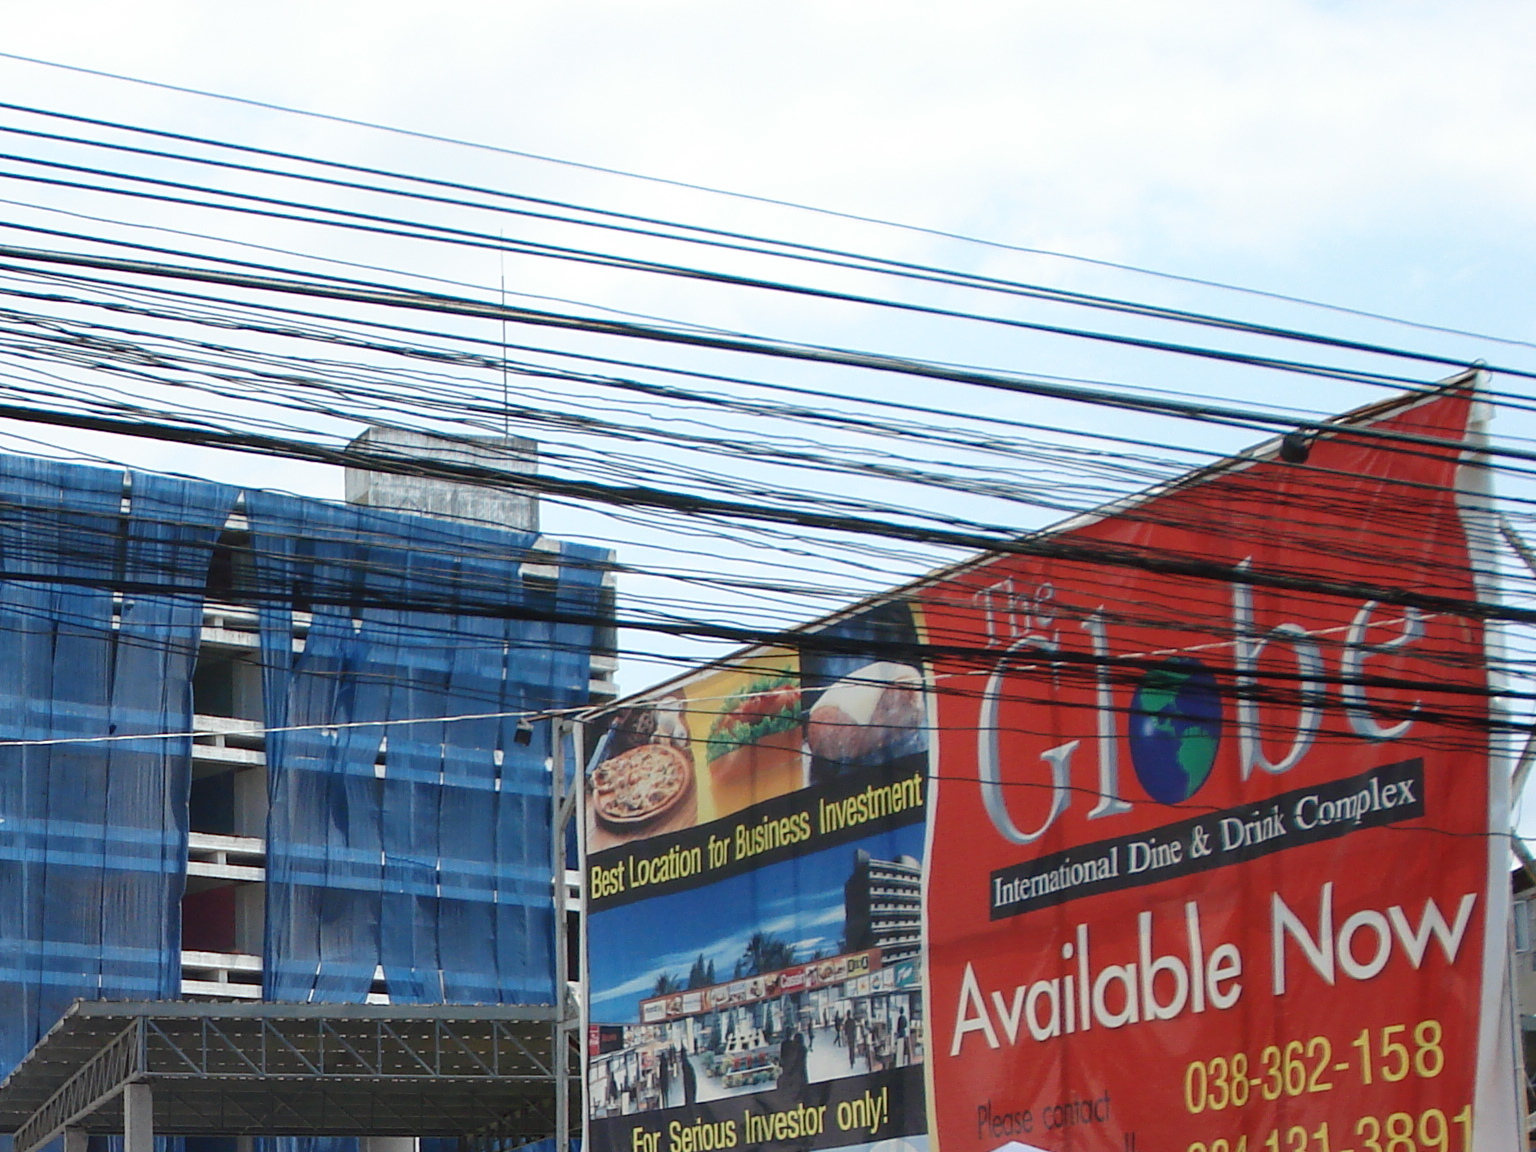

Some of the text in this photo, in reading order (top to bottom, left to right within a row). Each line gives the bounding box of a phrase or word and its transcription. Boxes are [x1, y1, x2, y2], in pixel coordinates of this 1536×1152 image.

[974, 577, 1057, 646] The
[591, 770, 923, 899] Best Location for Business Investment
[993, 776, 1418, 908] International Dine & Drink Complex
[949, 881, 1478, 1057] Available Now
[977, 1090, 1112, 1140] Please contact
[1185, 1020, 1445, 1115] 038-362-158
[745, 1102, 827, 1145] Investor
[837, 1086, 889, 1133] only!
